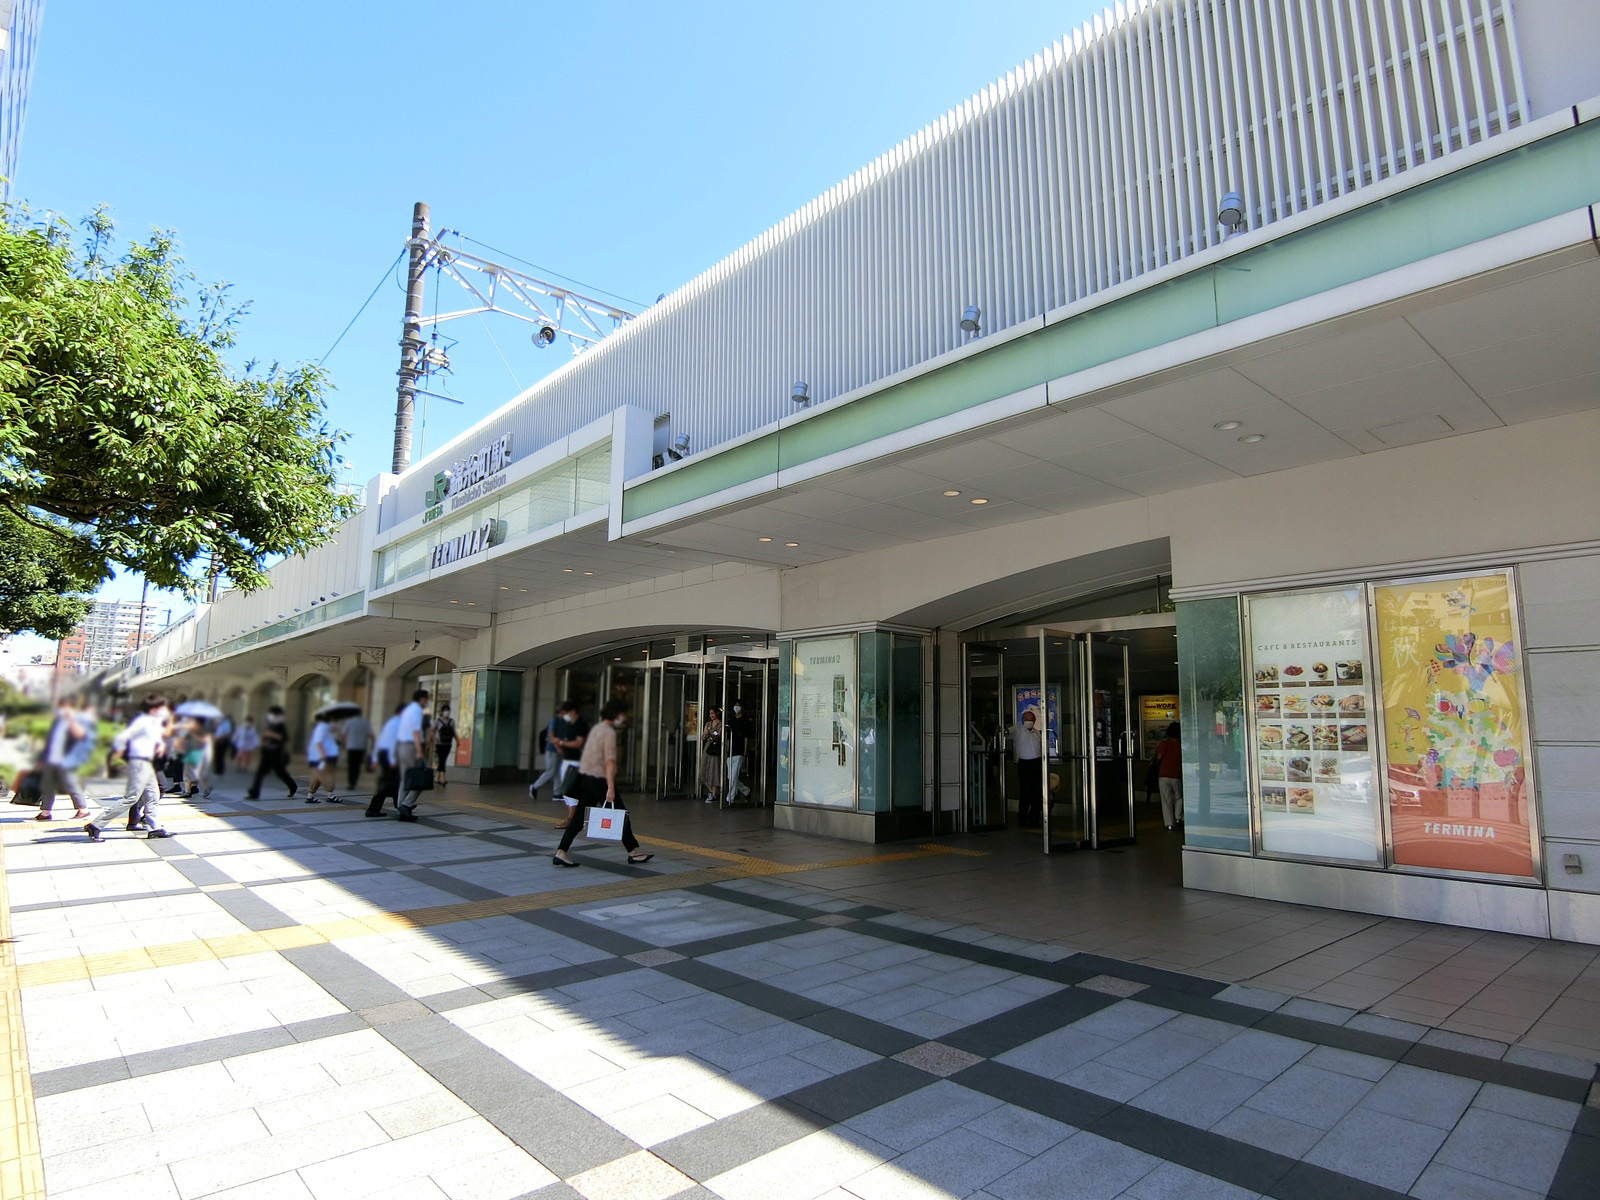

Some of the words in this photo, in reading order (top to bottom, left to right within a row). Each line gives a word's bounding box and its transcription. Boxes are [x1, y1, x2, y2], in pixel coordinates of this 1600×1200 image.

[425, 470, 450, 508] JR
[447, 432, 512, 497] 錦糸町駅
[482, 474, 506, 494] Station
[1290, 639, 1357, 649] RESTAURANTS
[1156, 702, 1177, 710] WORK
[1423, 822, 1496, 839] TERMINA
